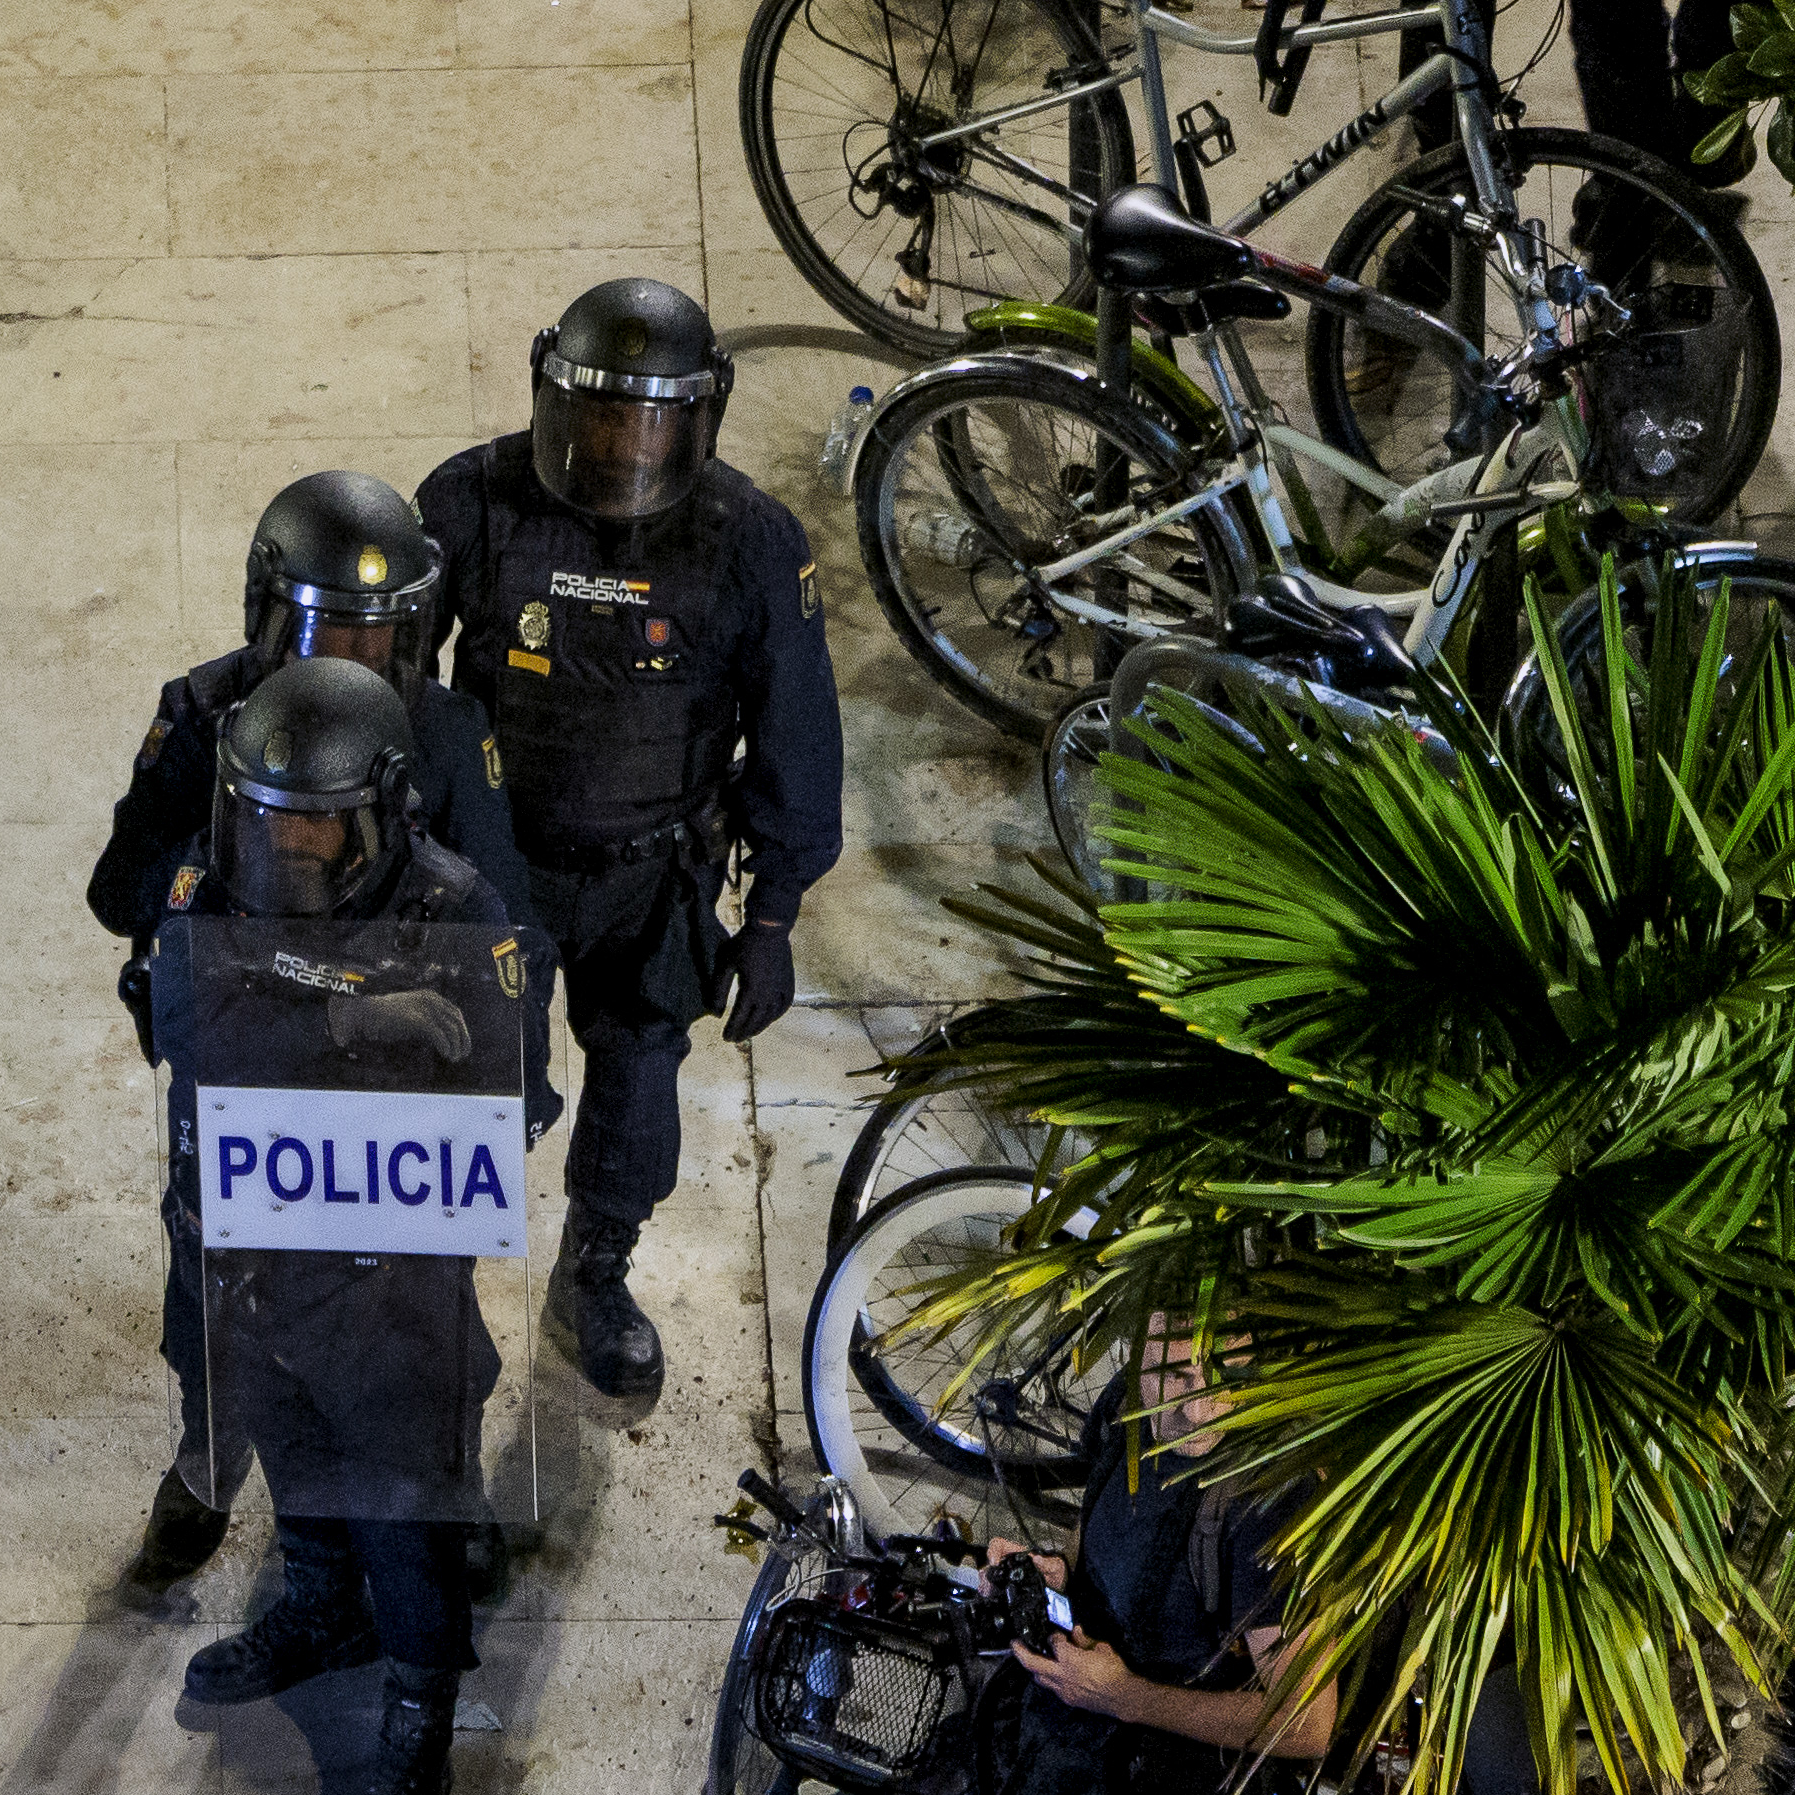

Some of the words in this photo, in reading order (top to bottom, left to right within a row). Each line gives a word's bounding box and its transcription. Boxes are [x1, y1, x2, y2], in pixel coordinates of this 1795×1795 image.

[551, 571, 630, 594] POLICIA
[550, 584, 649, 607] NACIONAL
[218, 1135, 509, 1211] POLICIA
